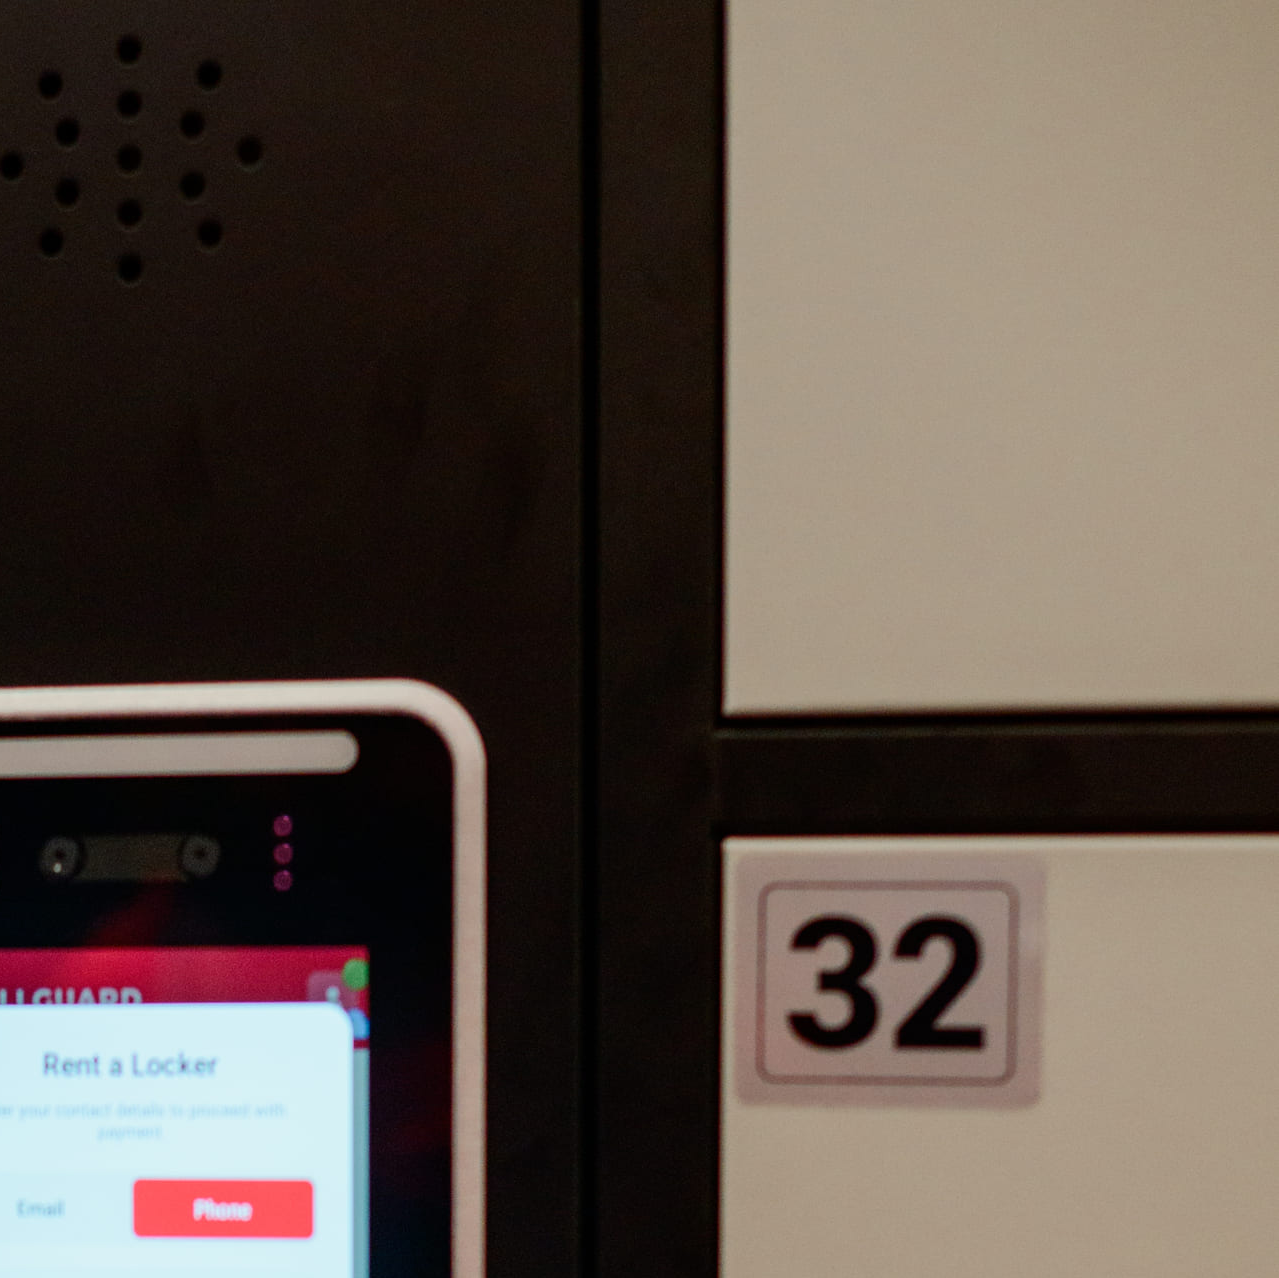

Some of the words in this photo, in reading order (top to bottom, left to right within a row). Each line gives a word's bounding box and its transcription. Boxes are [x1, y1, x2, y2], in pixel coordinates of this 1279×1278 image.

[787, 913, 985, 1050] 32
[43, 1053, 100, 1077] Rent
[109, 1060, 122, 1077] a
[132, 1053, 217, 1078] Locker
[17, 1201, 65, 1218] Email
[193, 1199, 253, 1222] Phone
